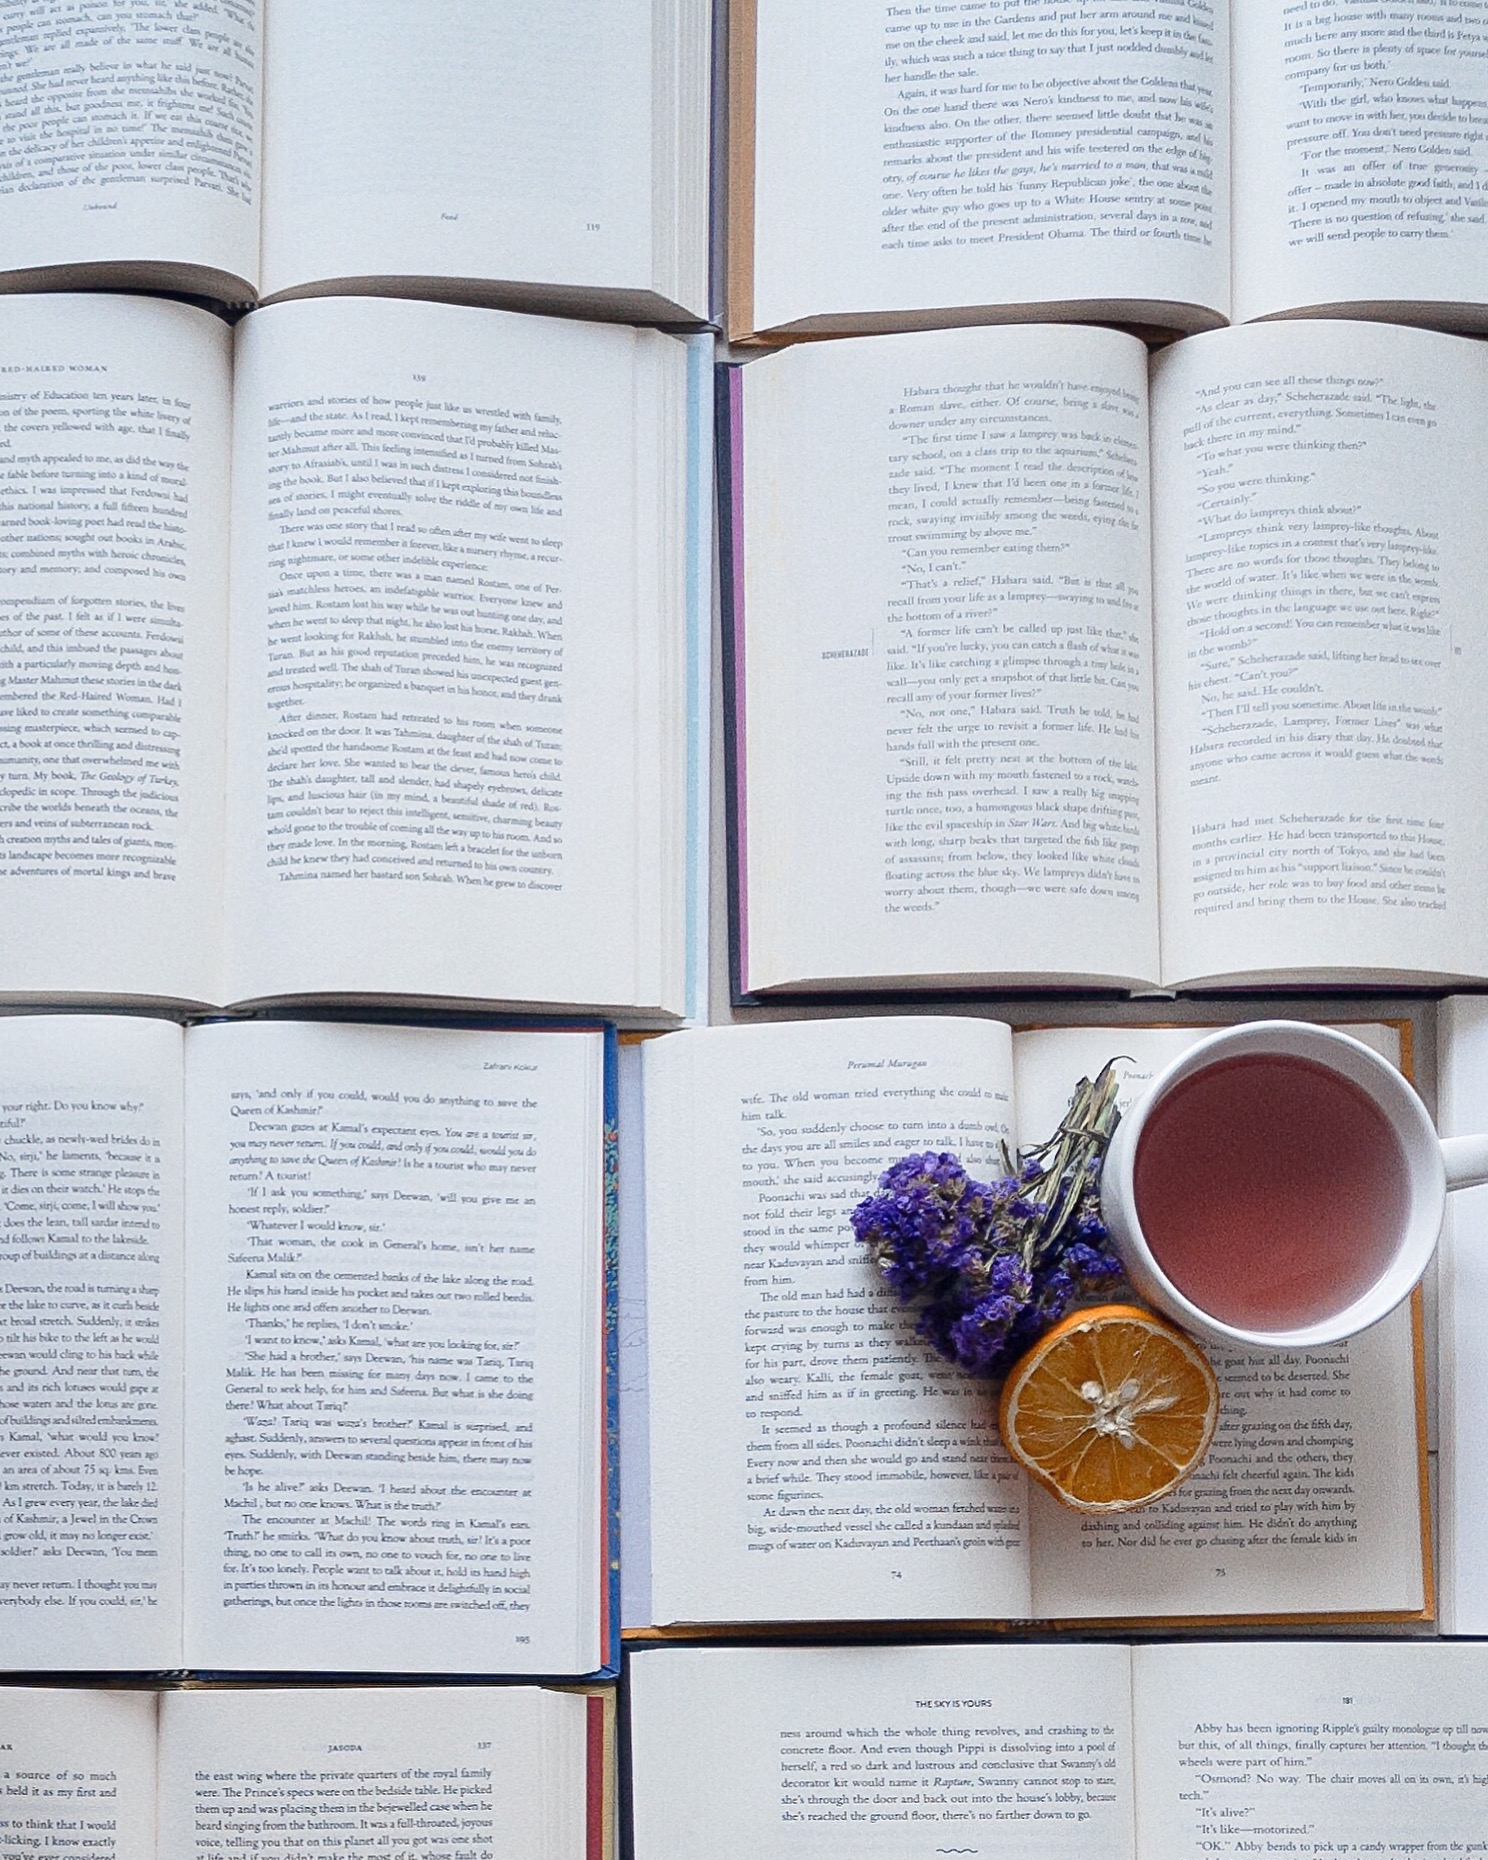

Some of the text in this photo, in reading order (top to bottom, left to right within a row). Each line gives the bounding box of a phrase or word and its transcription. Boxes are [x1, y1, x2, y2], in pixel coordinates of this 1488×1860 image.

[883, 66, 979, 83] her handle the sale.
[0, 364, 65, 374] RED-HAIRED
[68, 364, 108, 372] WOMAN
[887, 414, 1052, 431] downer under any circumstances.
[821, 647, 869, 660] SCHEHERAZADE
[740, 1108, 787, 1122] him talk.
[746, 1488, 824, 1503] stone figurines.
[914, 1698, 993, 1709] THE SKY IS YOURS
[327, 1743, 363, 1754] JASODA
